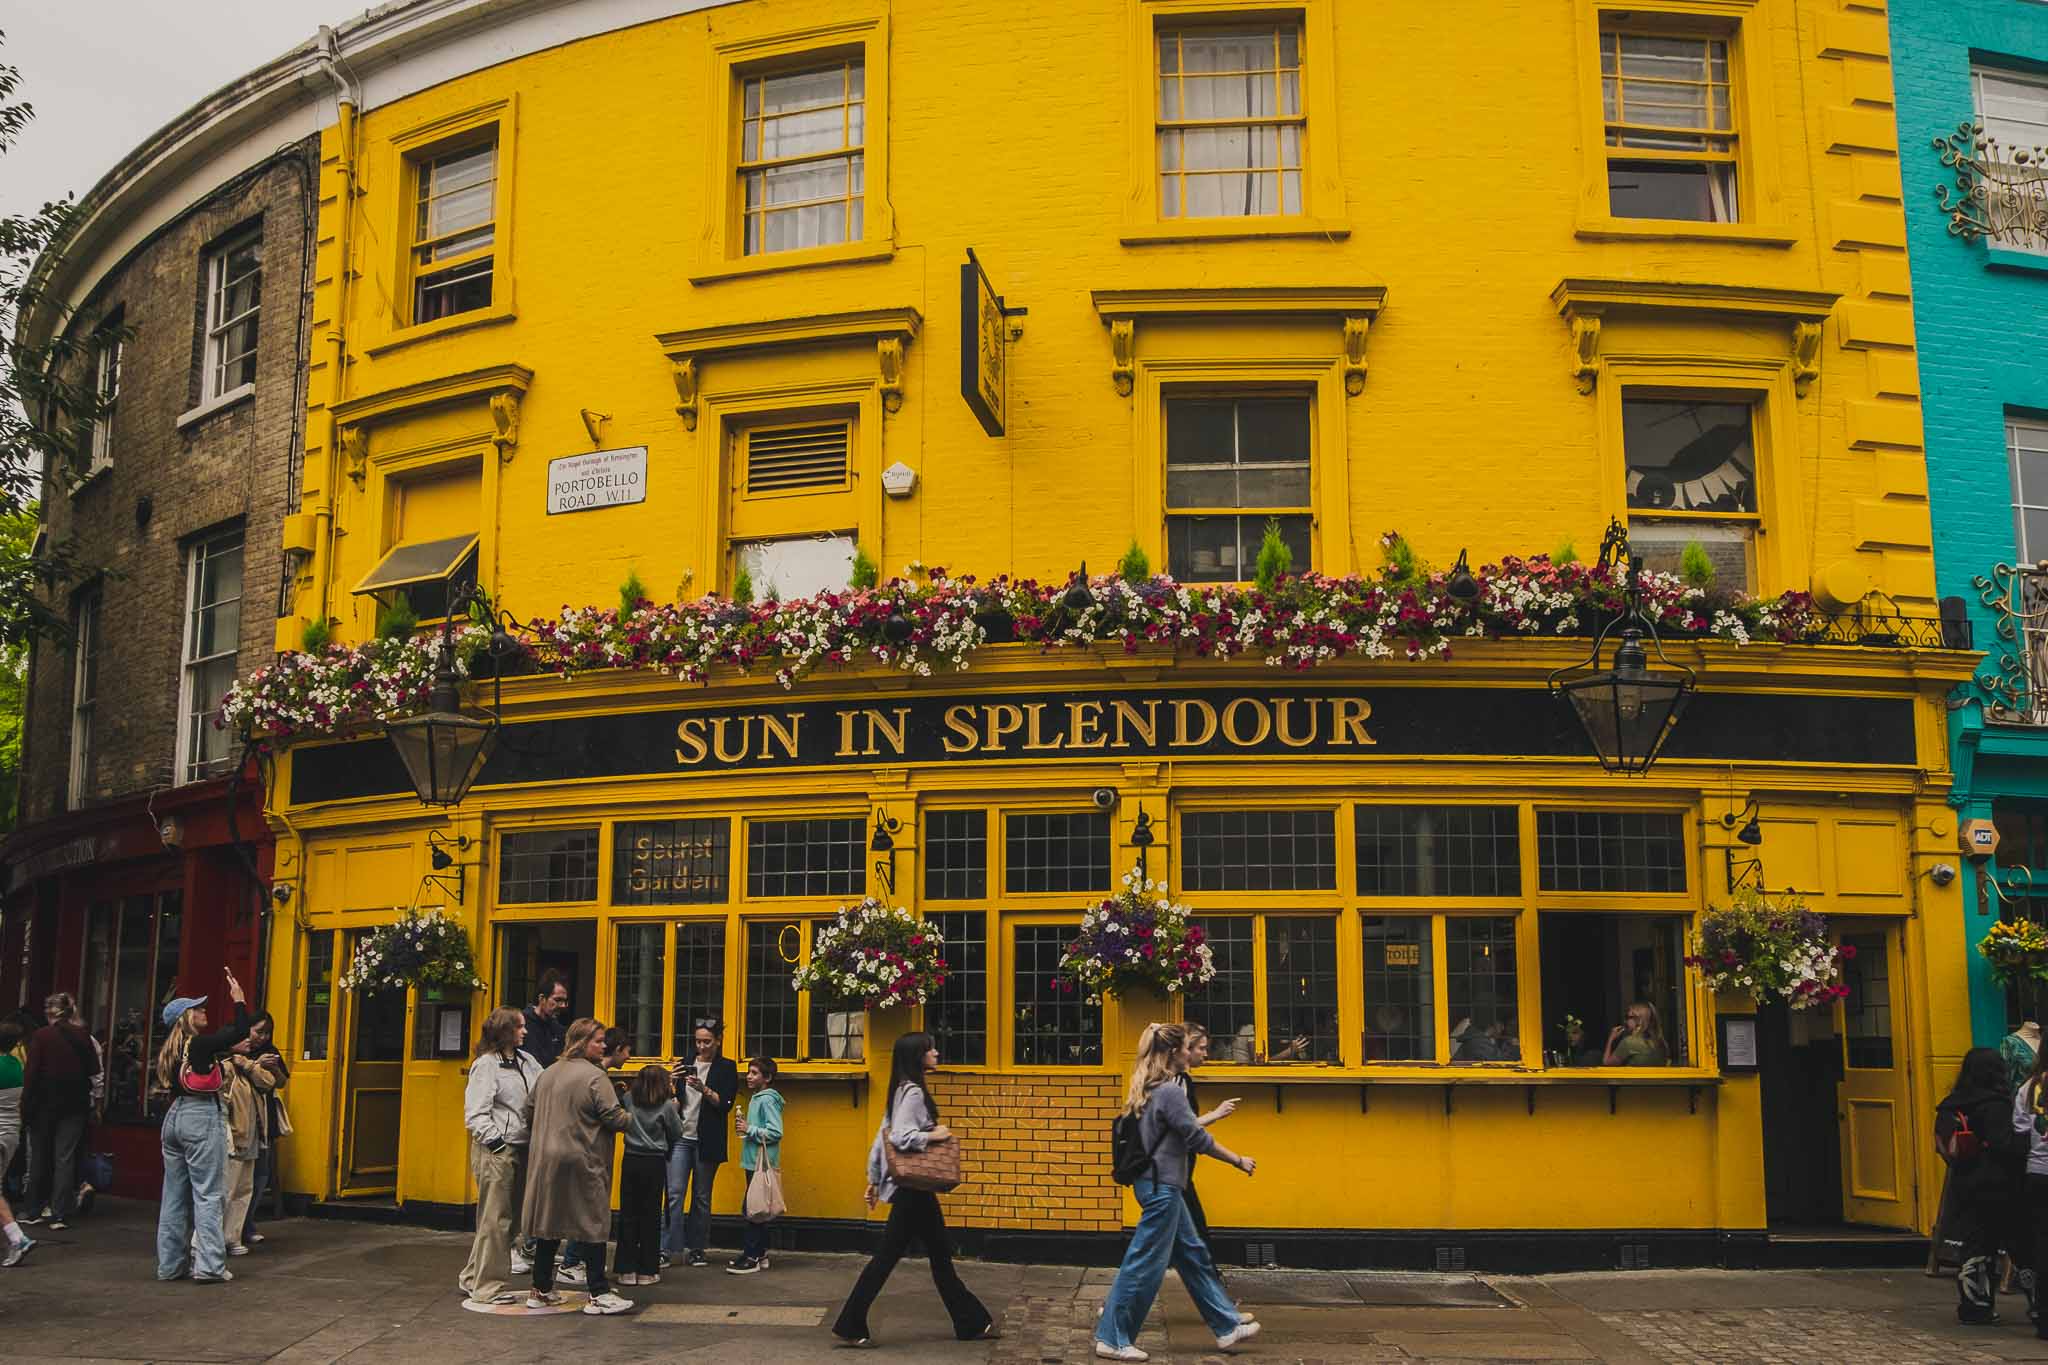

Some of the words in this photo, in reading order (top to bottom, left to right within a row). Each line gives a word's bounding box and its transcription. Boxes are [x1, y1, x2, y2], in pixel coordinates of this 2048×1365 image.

[555, 472, 639, 496] PORTOBELLO
[675, 712, 805, 764] SUN
[834, 708, 912, 757] IN
[941, 697, 1378, 754] SPLENDOUR
[636, 836, 713, 861] Secret
[1975, 832, 1992, 842] ADT
[632, 864, 719, 890] Garden
